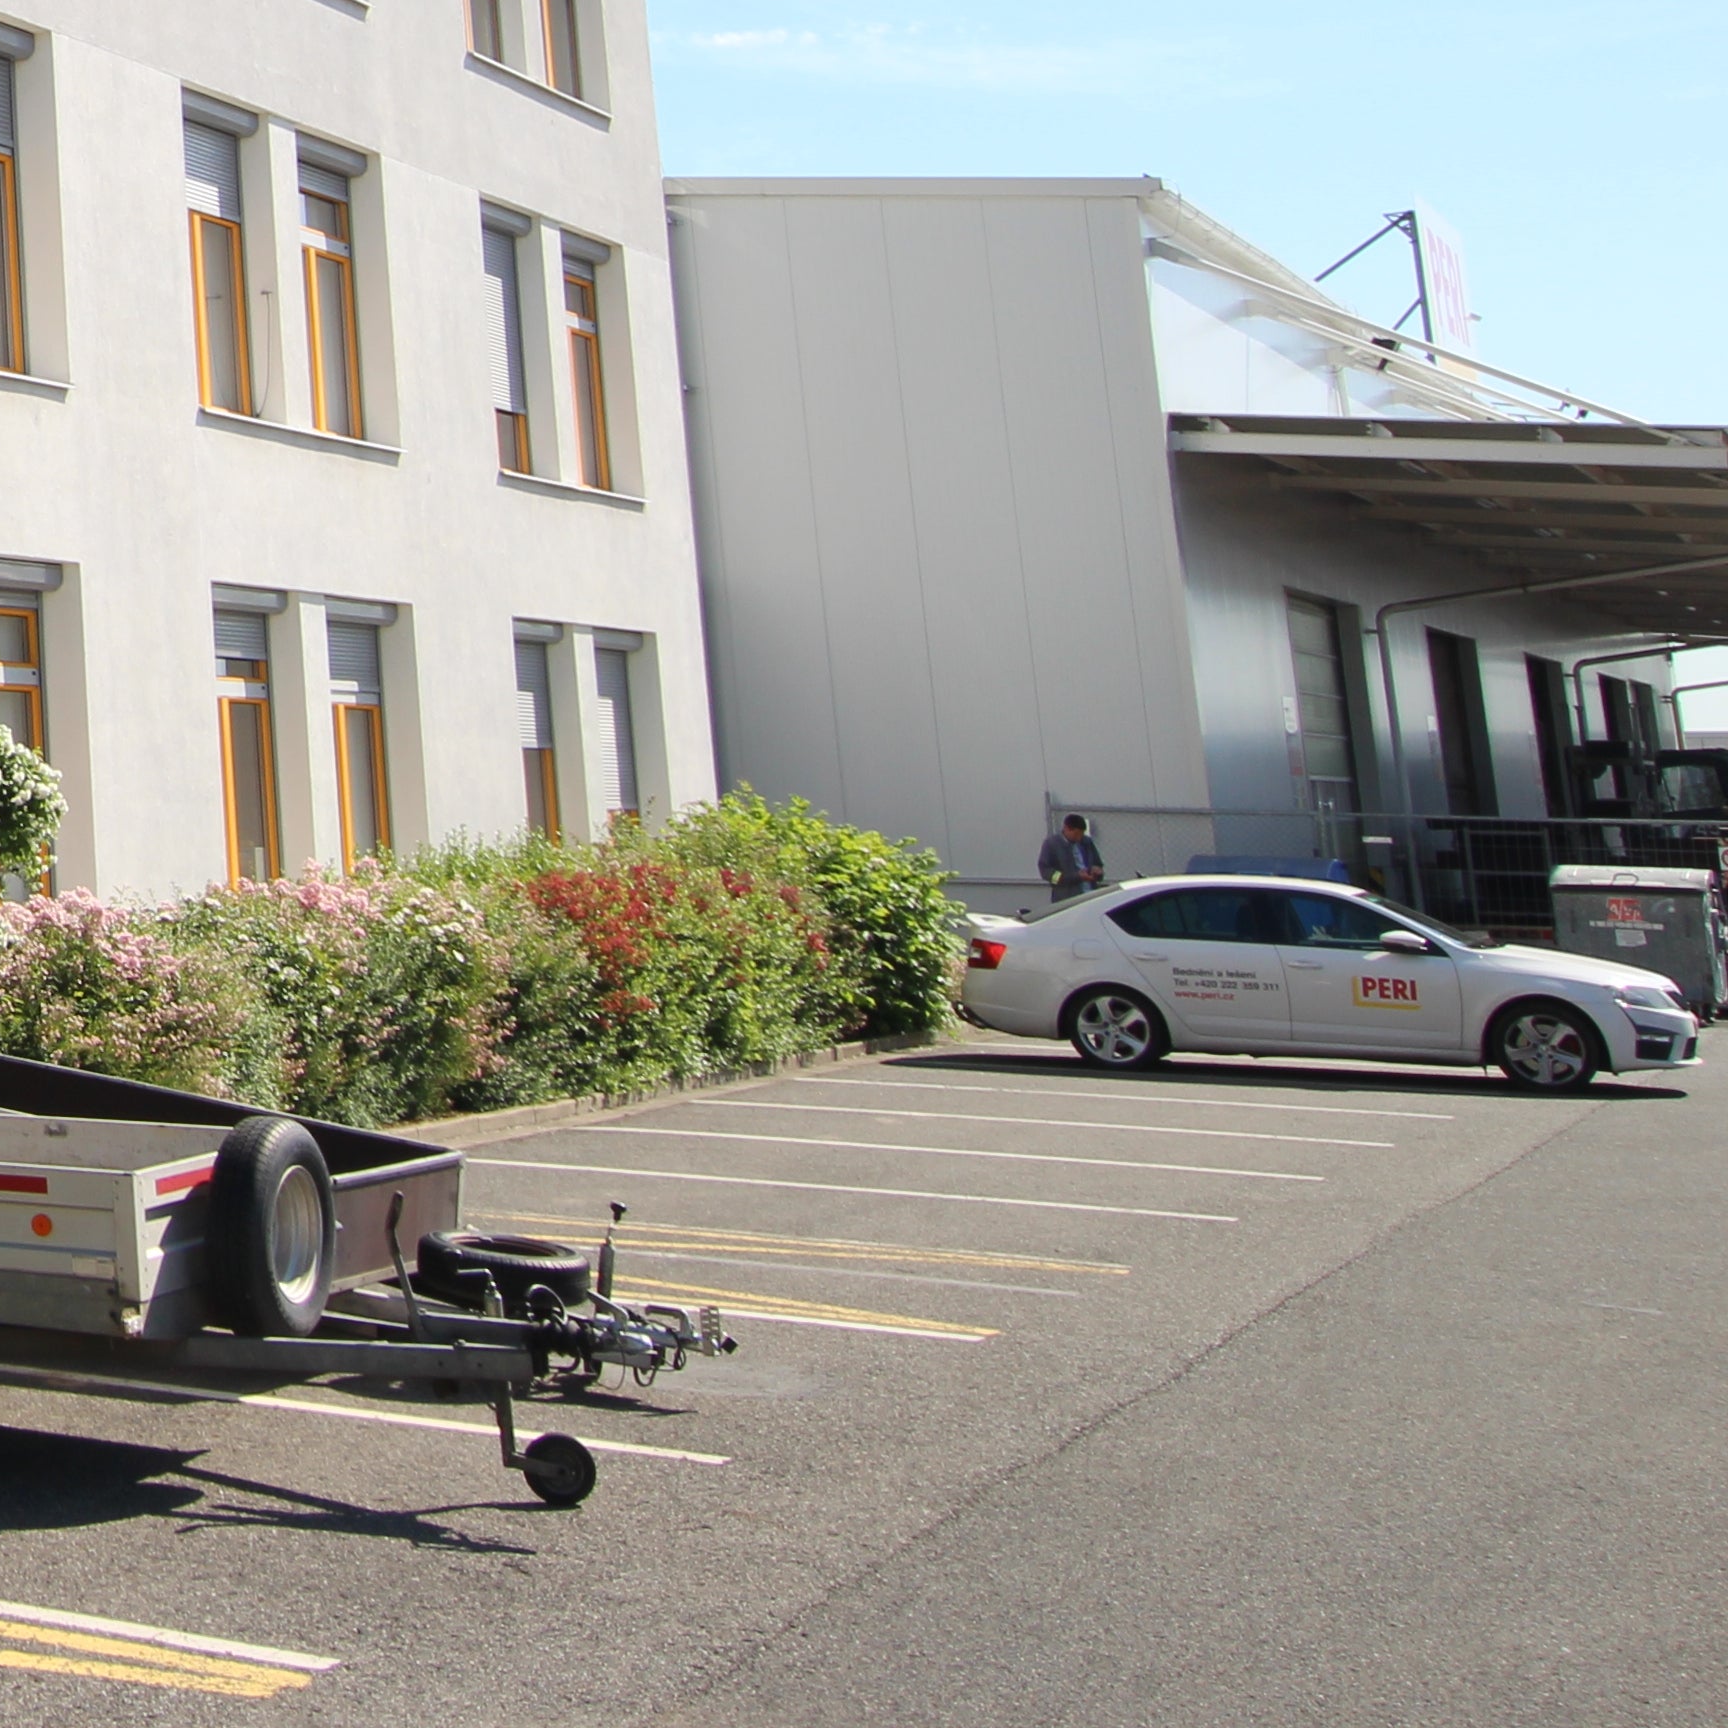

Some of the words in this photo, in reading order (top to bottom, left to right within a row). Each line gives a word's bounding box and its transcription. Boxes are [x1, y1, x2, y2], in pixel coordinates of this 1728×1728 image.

[1195, 980, 1218, 989] +420
[1220, 981, 1238, 990] 222
[1262, 983, 1279, 992] 311
[1362, 977, 1417, 1001] PERI
[1174, 991, 1235, 1001] www.peri.cz
